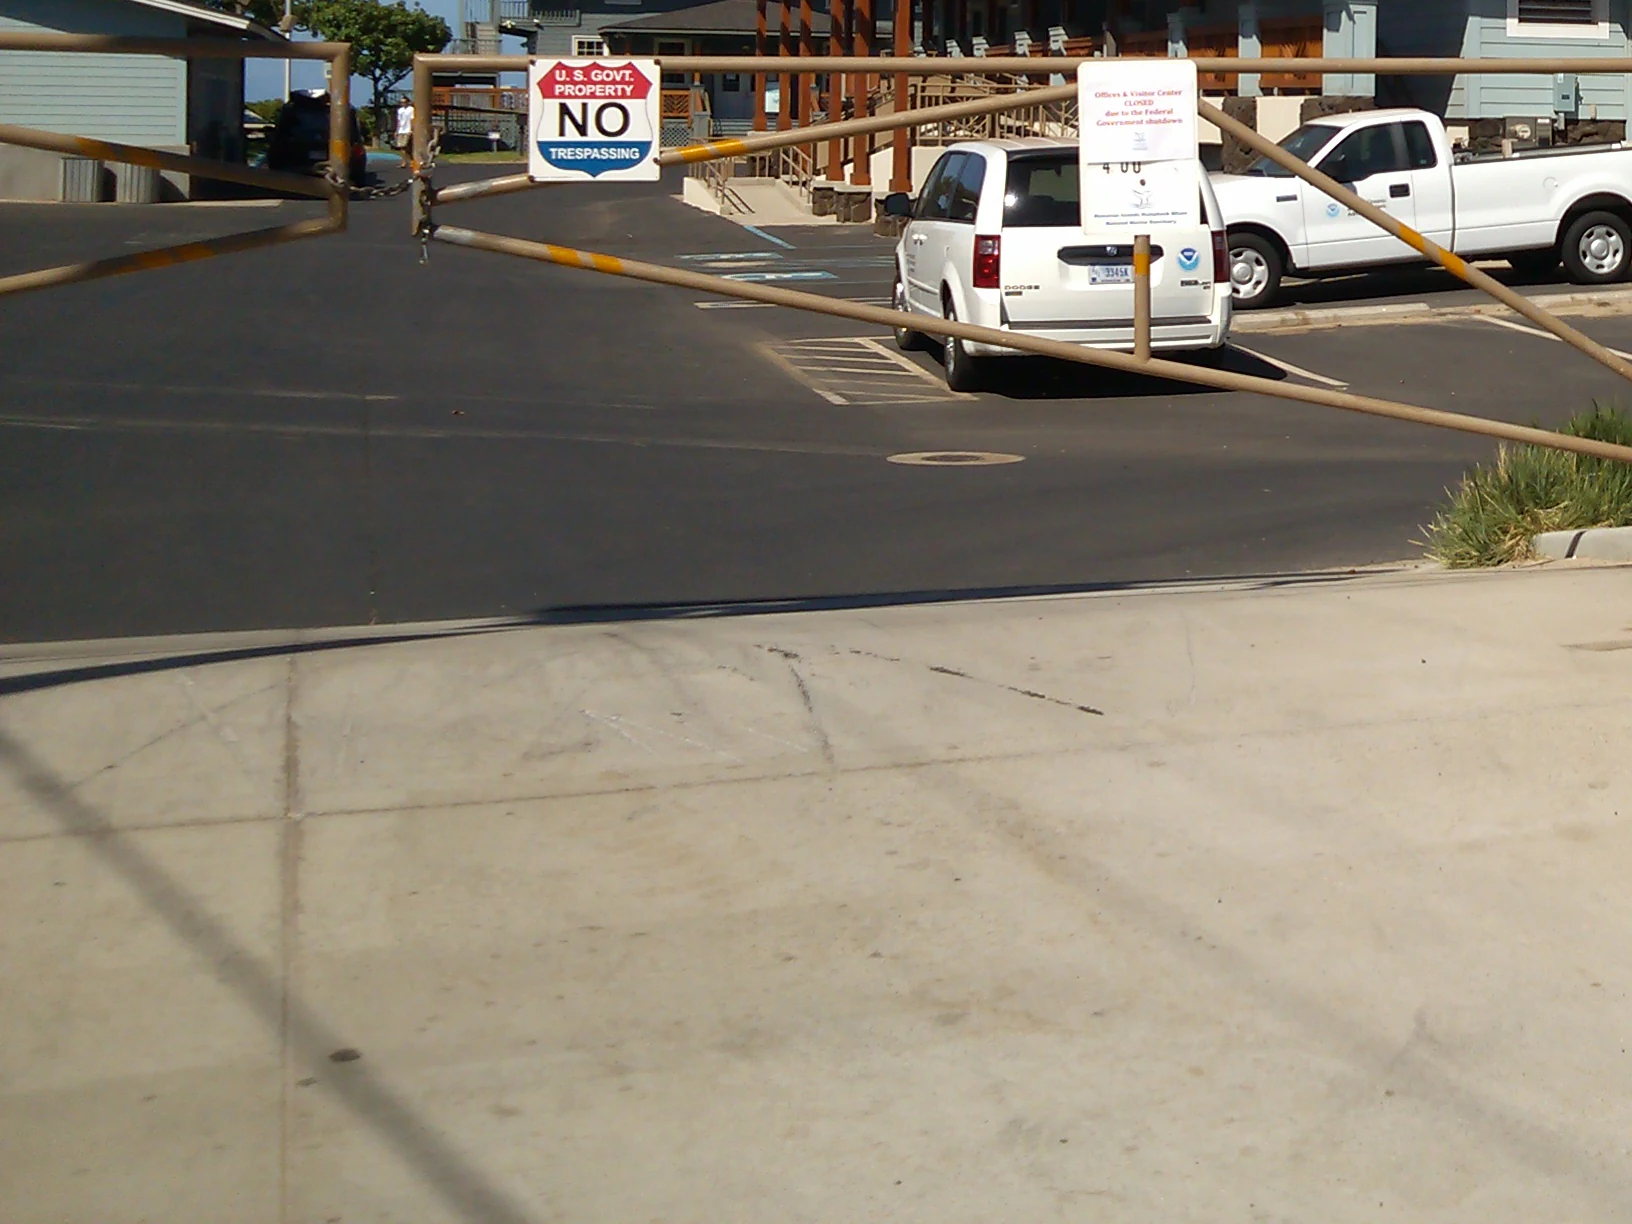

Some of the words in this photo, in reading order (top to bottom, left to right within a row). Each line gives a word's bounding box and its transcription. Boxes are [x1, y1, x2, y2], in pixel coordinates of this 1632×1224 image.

[555, 70, 570, 81] U.
[573, 70, 588, 81] S.
[591, 70, 635, 81] GOVT.
[554, 85, 634, 96] PROPERTY
[1157, 89, 1183, 97] Center
[1124, 99, 1154, 107] CLOSED
[558, 102, 630, 137] NO
[549, 147, 640, 160] TRESPASSING
